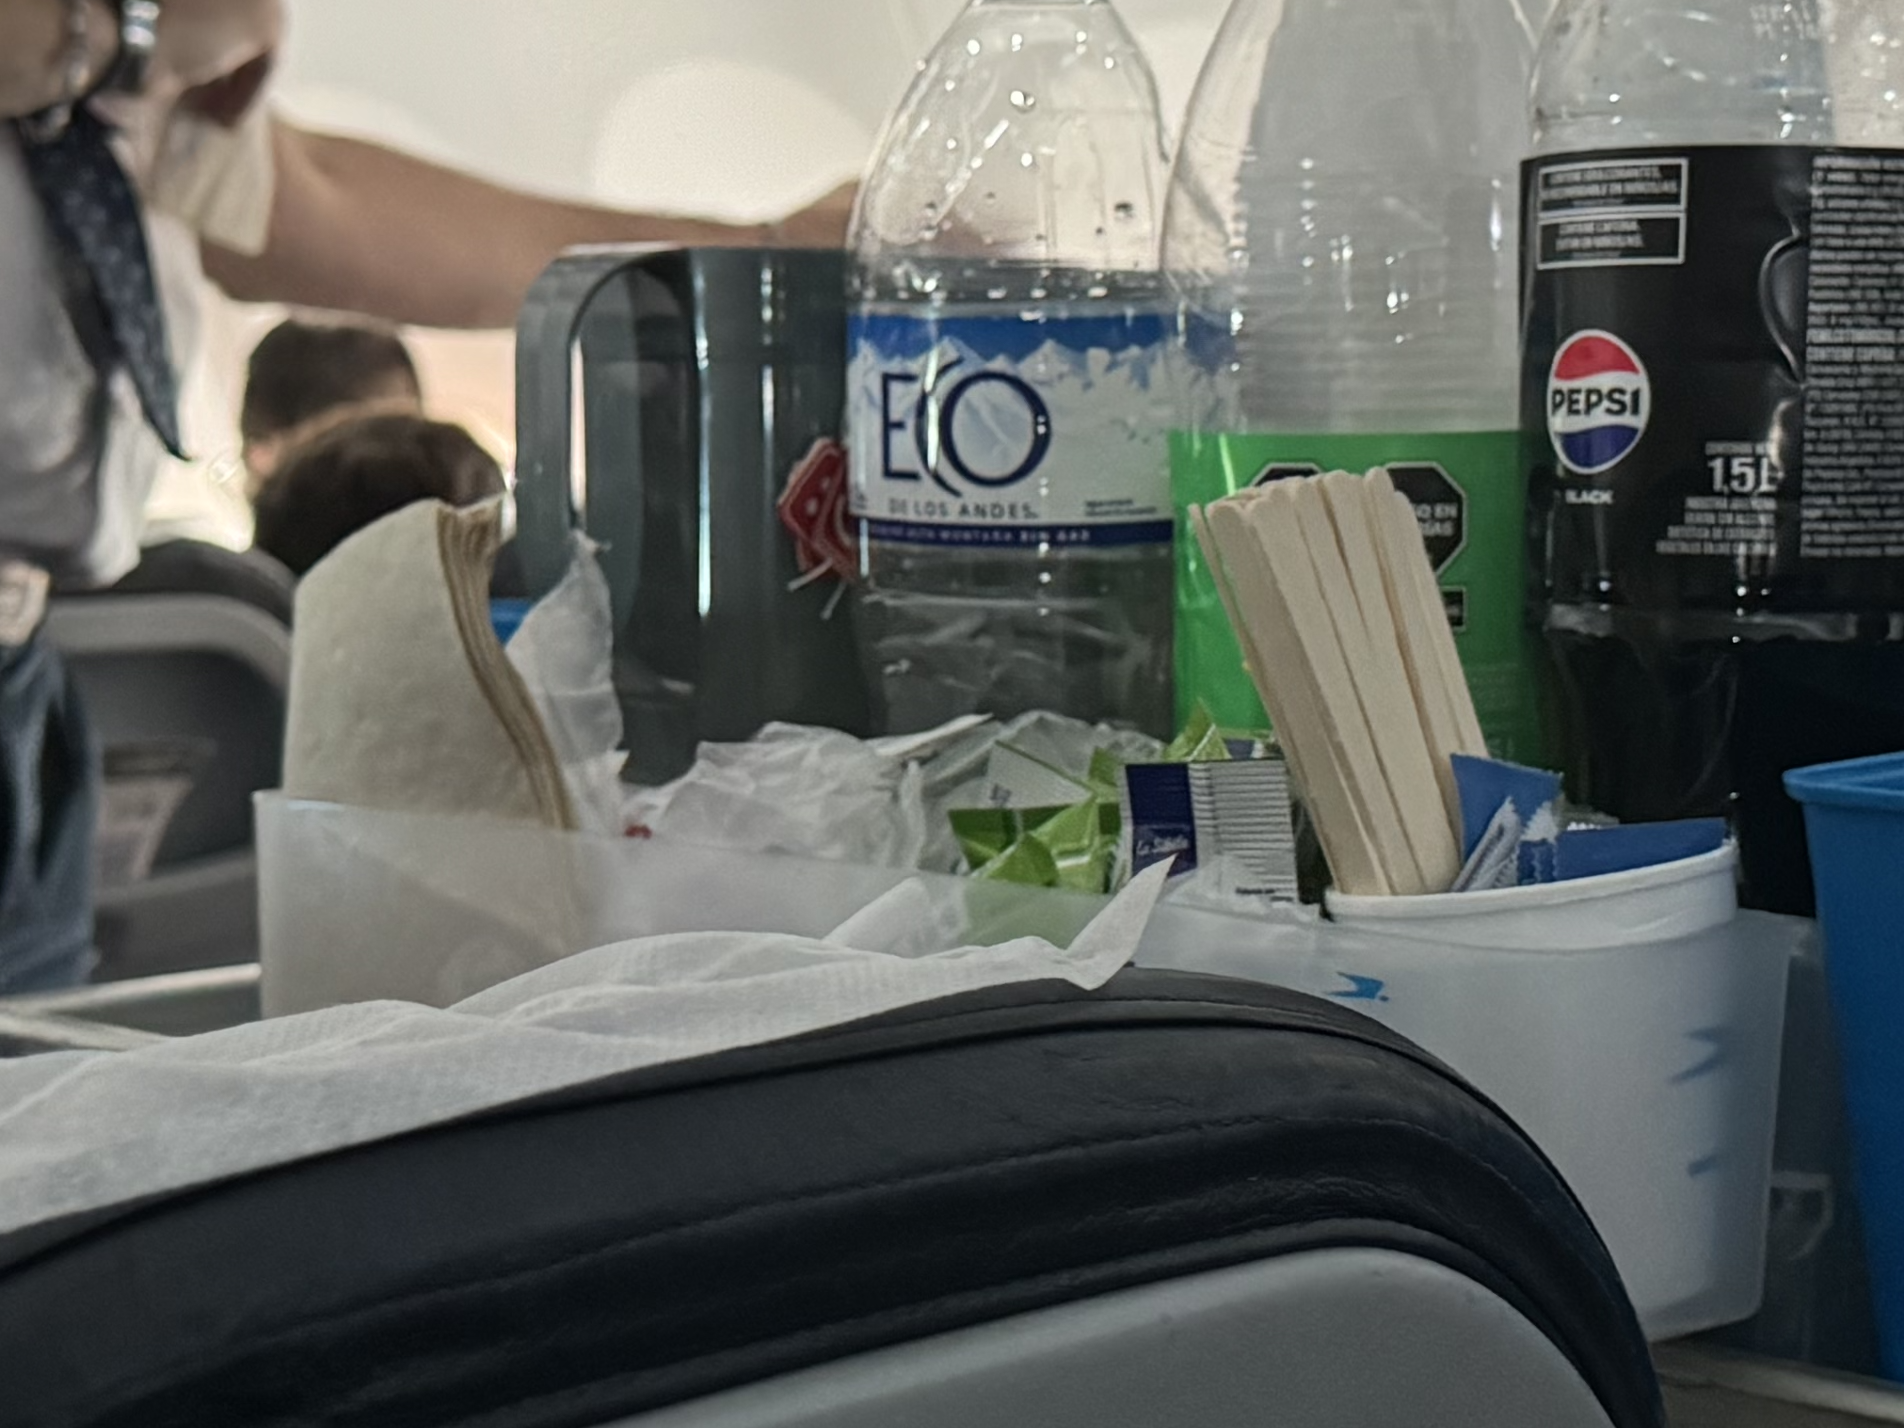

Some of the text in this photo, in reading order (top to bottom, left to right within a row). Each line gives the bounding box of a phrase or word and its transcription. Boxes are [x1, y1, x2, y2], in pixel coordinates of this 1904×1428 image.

[1552, 387, 1641, 416] PEPSI
[882, 356, 1052, 497] ECO
[1565, 488, 1614, 505] BLACK
[889, 498, 1033, 519] DE LOS ANDES
[1434, 502, 1457, 518] EN
